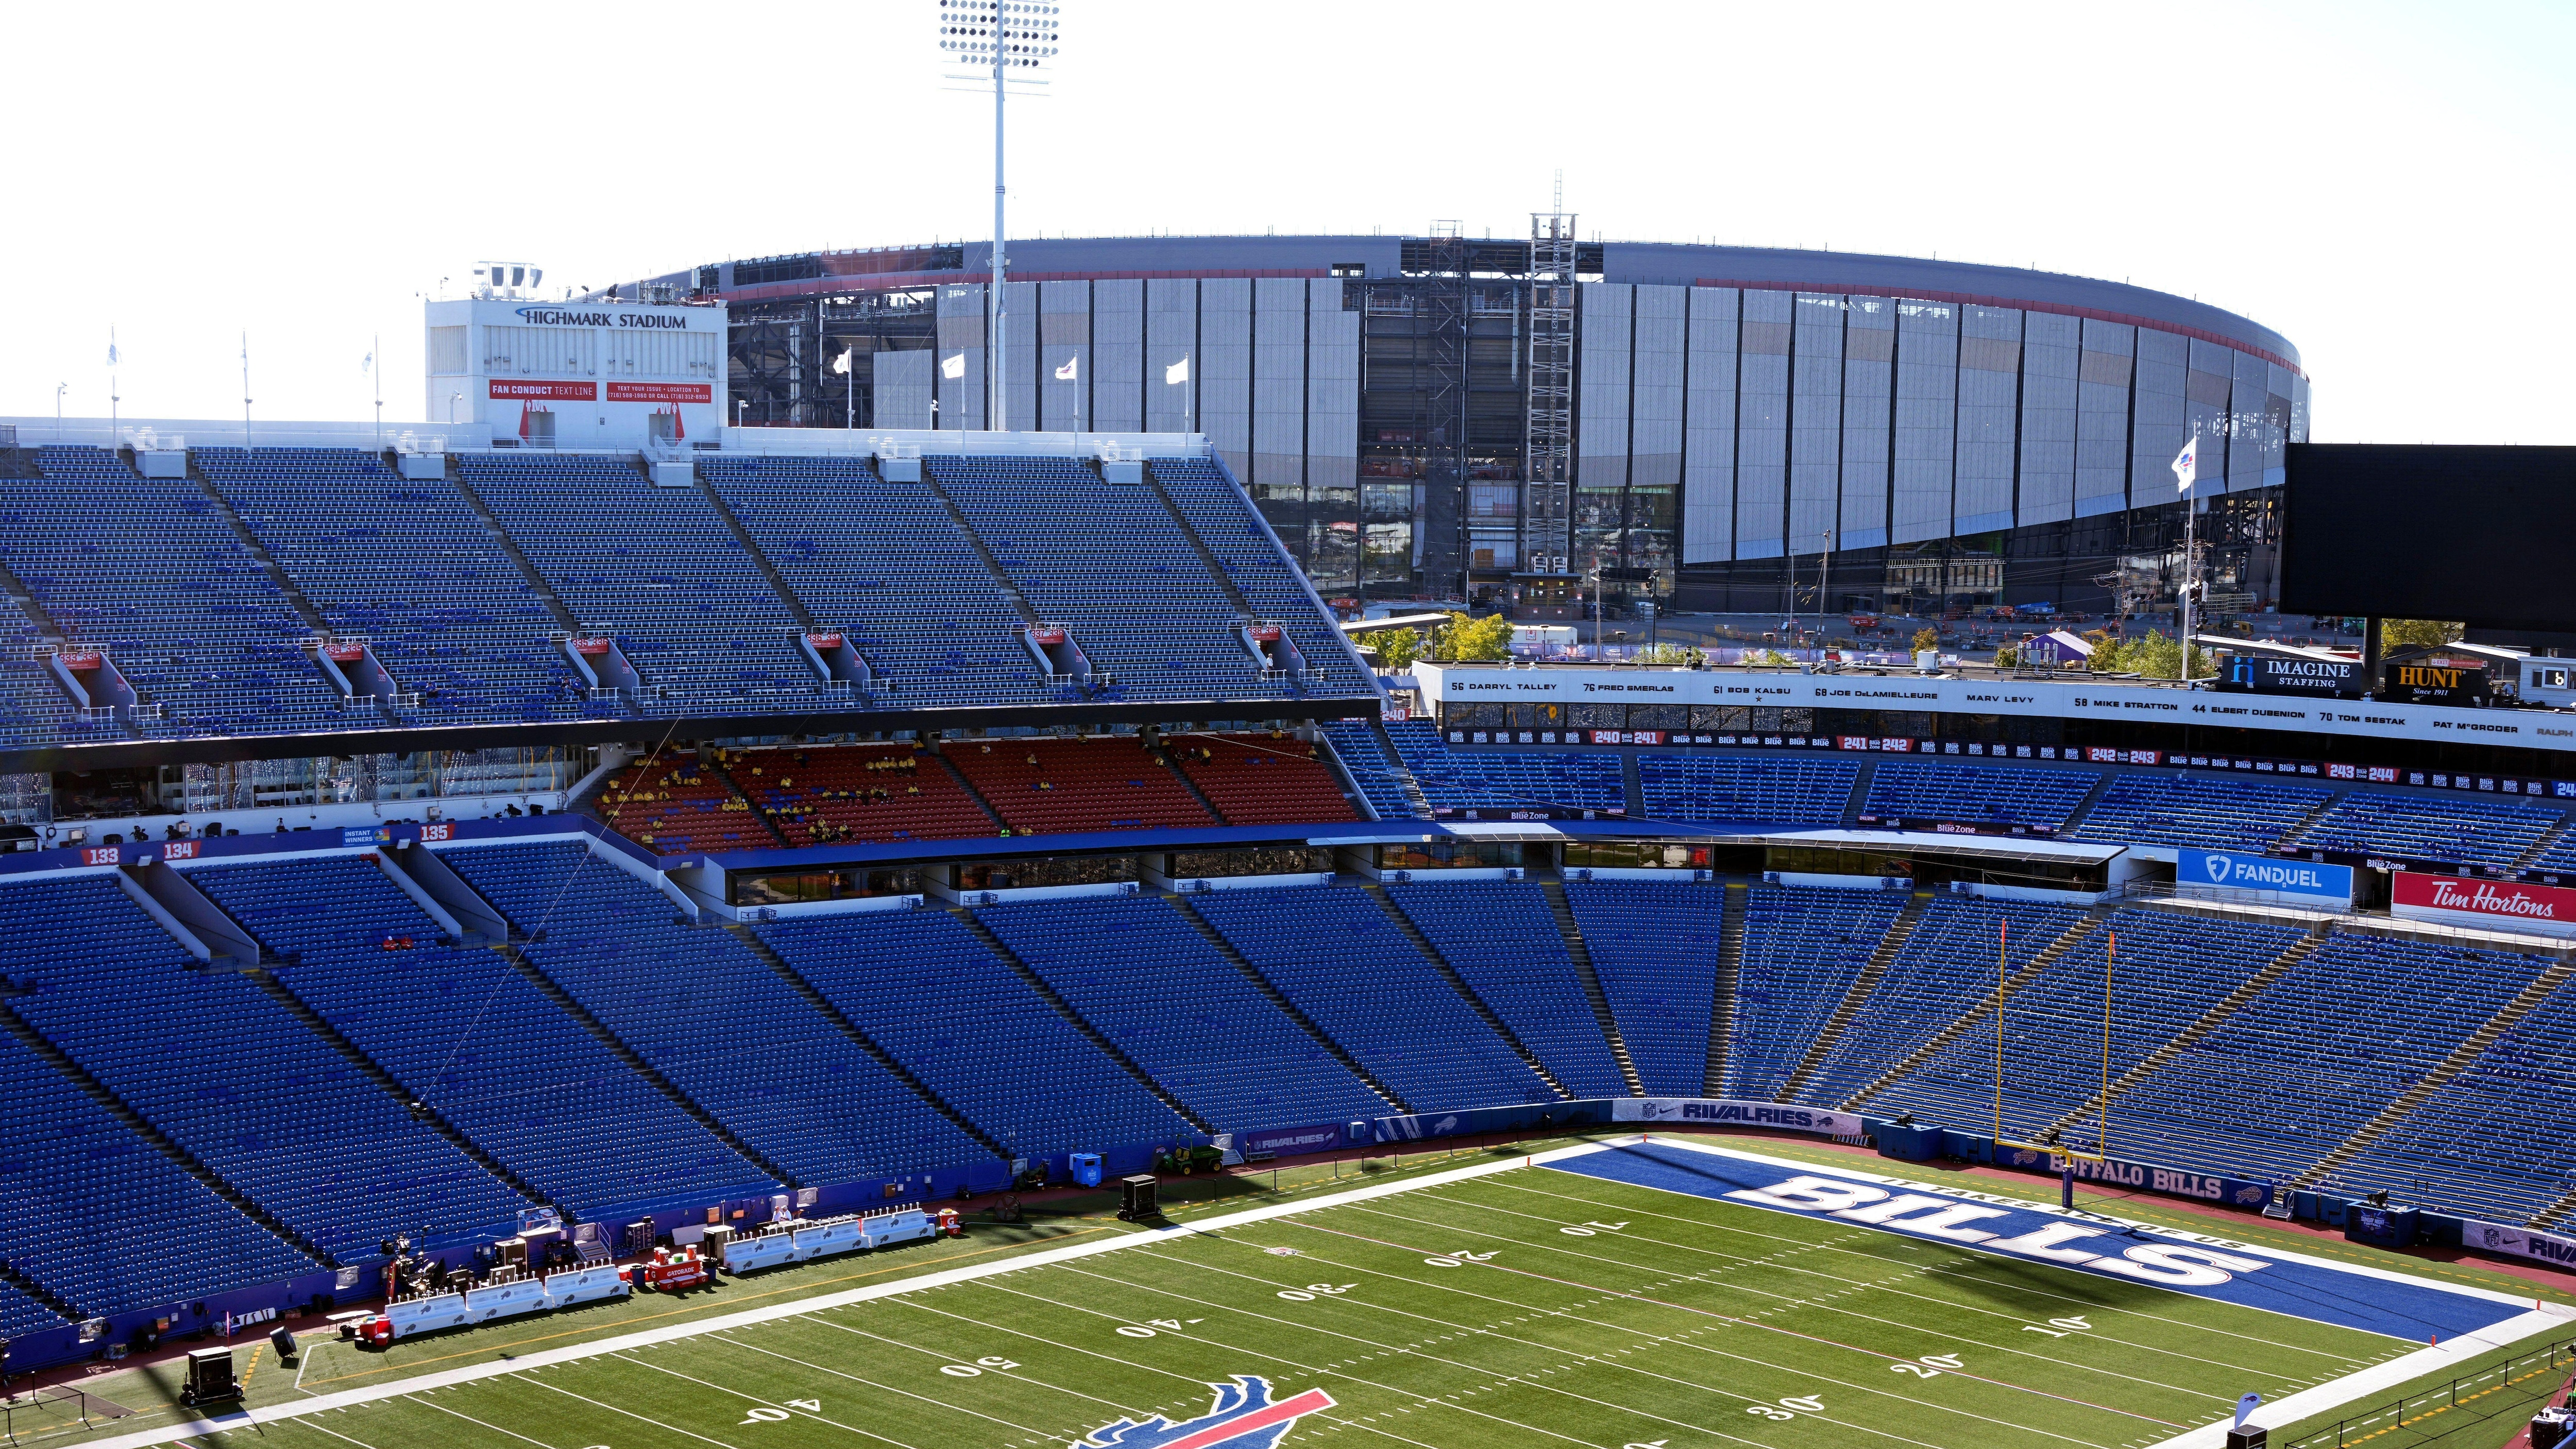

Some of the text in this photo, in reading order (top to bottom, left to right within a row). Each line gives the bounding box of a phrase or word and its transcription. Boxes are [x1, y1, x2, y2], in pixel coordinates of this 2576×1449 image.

[527, 310, 687, 329] HIGHMARK STADIUM
[493, 385, 592, 396] FAN CONDUCT TEXT LINE
[2267, 660, 2350, 678] IMAGINE
[2279, 677, 2336, 688] STAFFING
[2399, 667, 2462, 688] HUNT
[1815, 688, 1827, 696] 68
[2075, 698, 2087, 706] 58
[2125, 702, 2178, 710] STRATTON
[1382, 709, 1405, 721] 240
[2192, 705, 2305, 718] 44 ELBERT DUBENION
[2319, 712, 2332, 721] 70
[2365, 717, 2406, 725] SESTAK
[1595, 731, 1620, 743] 240
[1634, 731, 1657, 744] 241
[2537, 728, 2573, 738] RALPH
[1844, 737, 1867, 749] 241
[1883, 738, 1907, 751] 242
[2092, 748, 2115, 761] 242
[2130, 751, 2155, 764] 243
[2300, 765, 2317, 774] Blue
[2330, 764, 2354, 778] 243
[2369, 768, 2394, 782] 244
[2557, 782, 2576, 796] 24
[421, 825, 448, 841] 135
[1955, 825, 1975, 833] Zone
[90, 848, 118, 864] 133
[165, 843, 193, 859] 134
[2366, 859, 2406, 871] Blue Zone
[2235, 863, 2322, 888] FANDUEL
[2432, 881, 2553, 917] Tim Hortons
[1683, 1104, 1812, 1127] RIVALRIES
[1262, 1134, 1324, 1149] RIVALRIES
[2153, 1169, 2222, 1199] BILLS
[947, 1217, 955, 1225] G
[1937, 1188, 2043, 1208] TAKES
[2058, 1207, 2115, 1223] ALL
[2138, 1225, 2181, 1235] OF
[2199, 1238, 2247, 1249] US
[1560, 1221, 1624, 1236] 10
[1721, 1175, 2273, 1286] BILLS
[2485, 1236, 2498, 1245] NFL
[1424, 1250, 1492, 1267] 20
[667, 1267, 694, 1277] GATORADE
[1277, 1284, 1347, 1301] 30
[1116, 1319, 1182, 1338] 40
[2021, 1318, 2092, 1337] 10
[940, 1356, 1022, 1376] 50
[1890, 1356, 1964, 1378] 20
[747, 1399, 821, 1421] 40
[1747, 1398, 1825, 1420] 30
